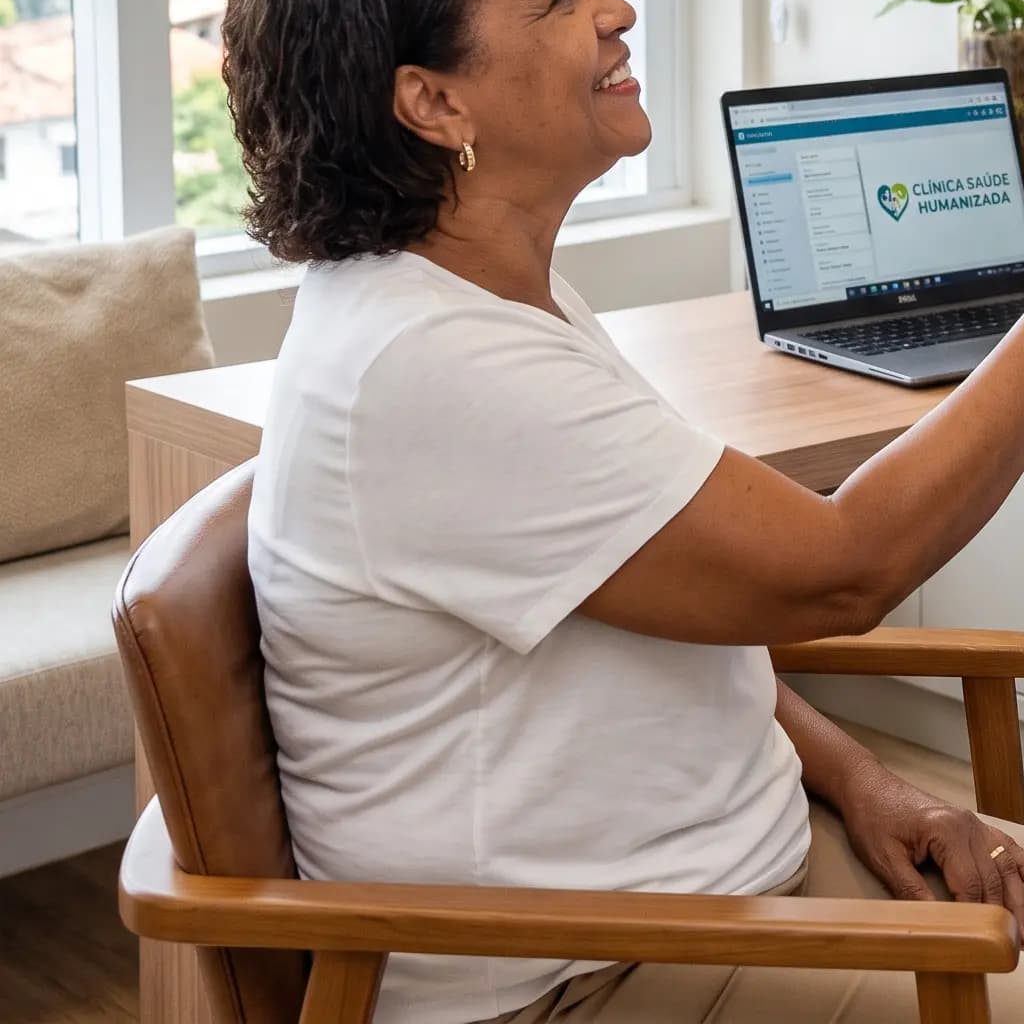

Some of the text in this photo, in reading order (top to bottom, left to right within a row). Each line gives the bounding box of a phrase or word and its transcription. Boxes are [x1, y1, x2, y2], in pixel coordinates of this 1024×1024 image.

[912, 171, 1011, 196] CLÍNICA SAÚDE
[918, 191, 1011, 214] HUMANIZADA
